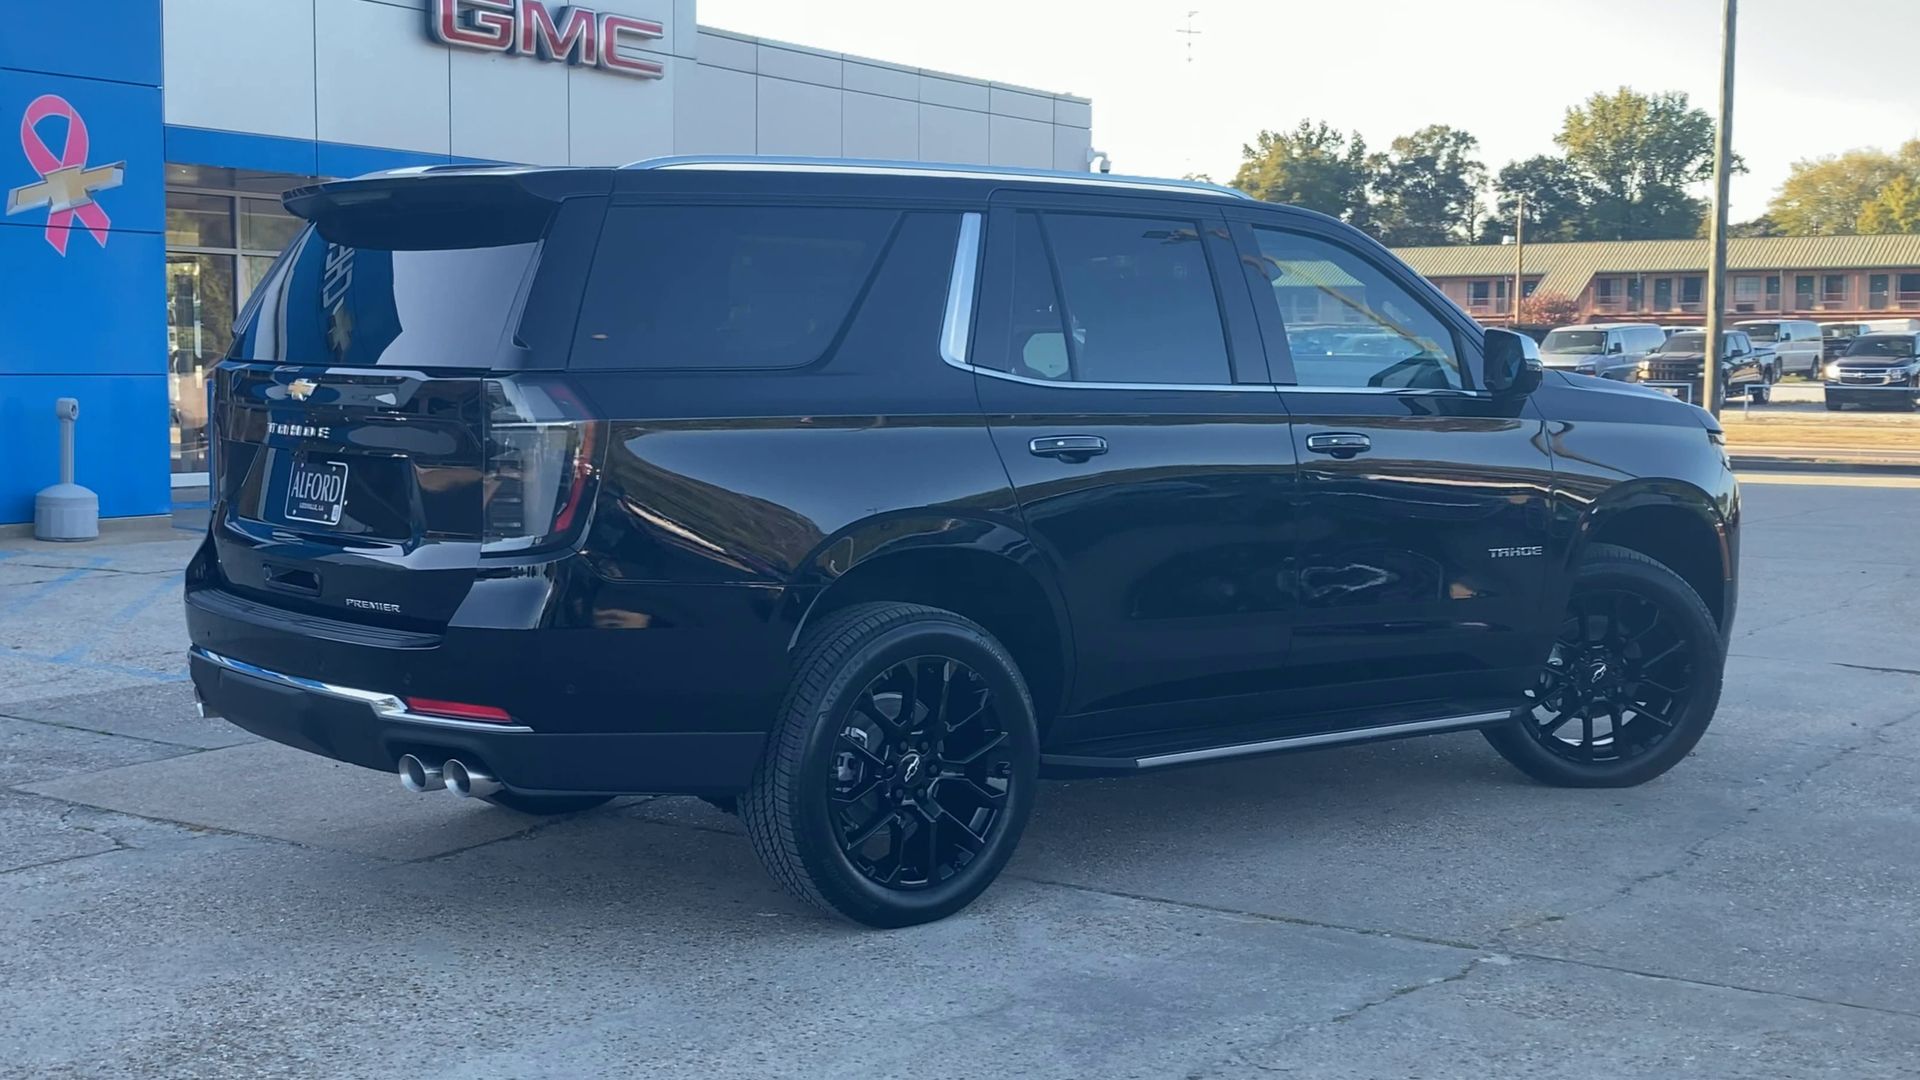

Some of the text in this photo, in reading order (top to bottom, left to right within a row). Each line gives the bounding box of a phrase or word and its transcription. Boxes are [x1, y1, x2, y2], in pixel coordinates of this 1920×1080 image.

[430, 0, 665, 79] GMC
[290, 471, 341, 502] ALFORD
[1488, 545, 1543, 558] TAHOE
[345, 598, 401, 613] PREMIER
